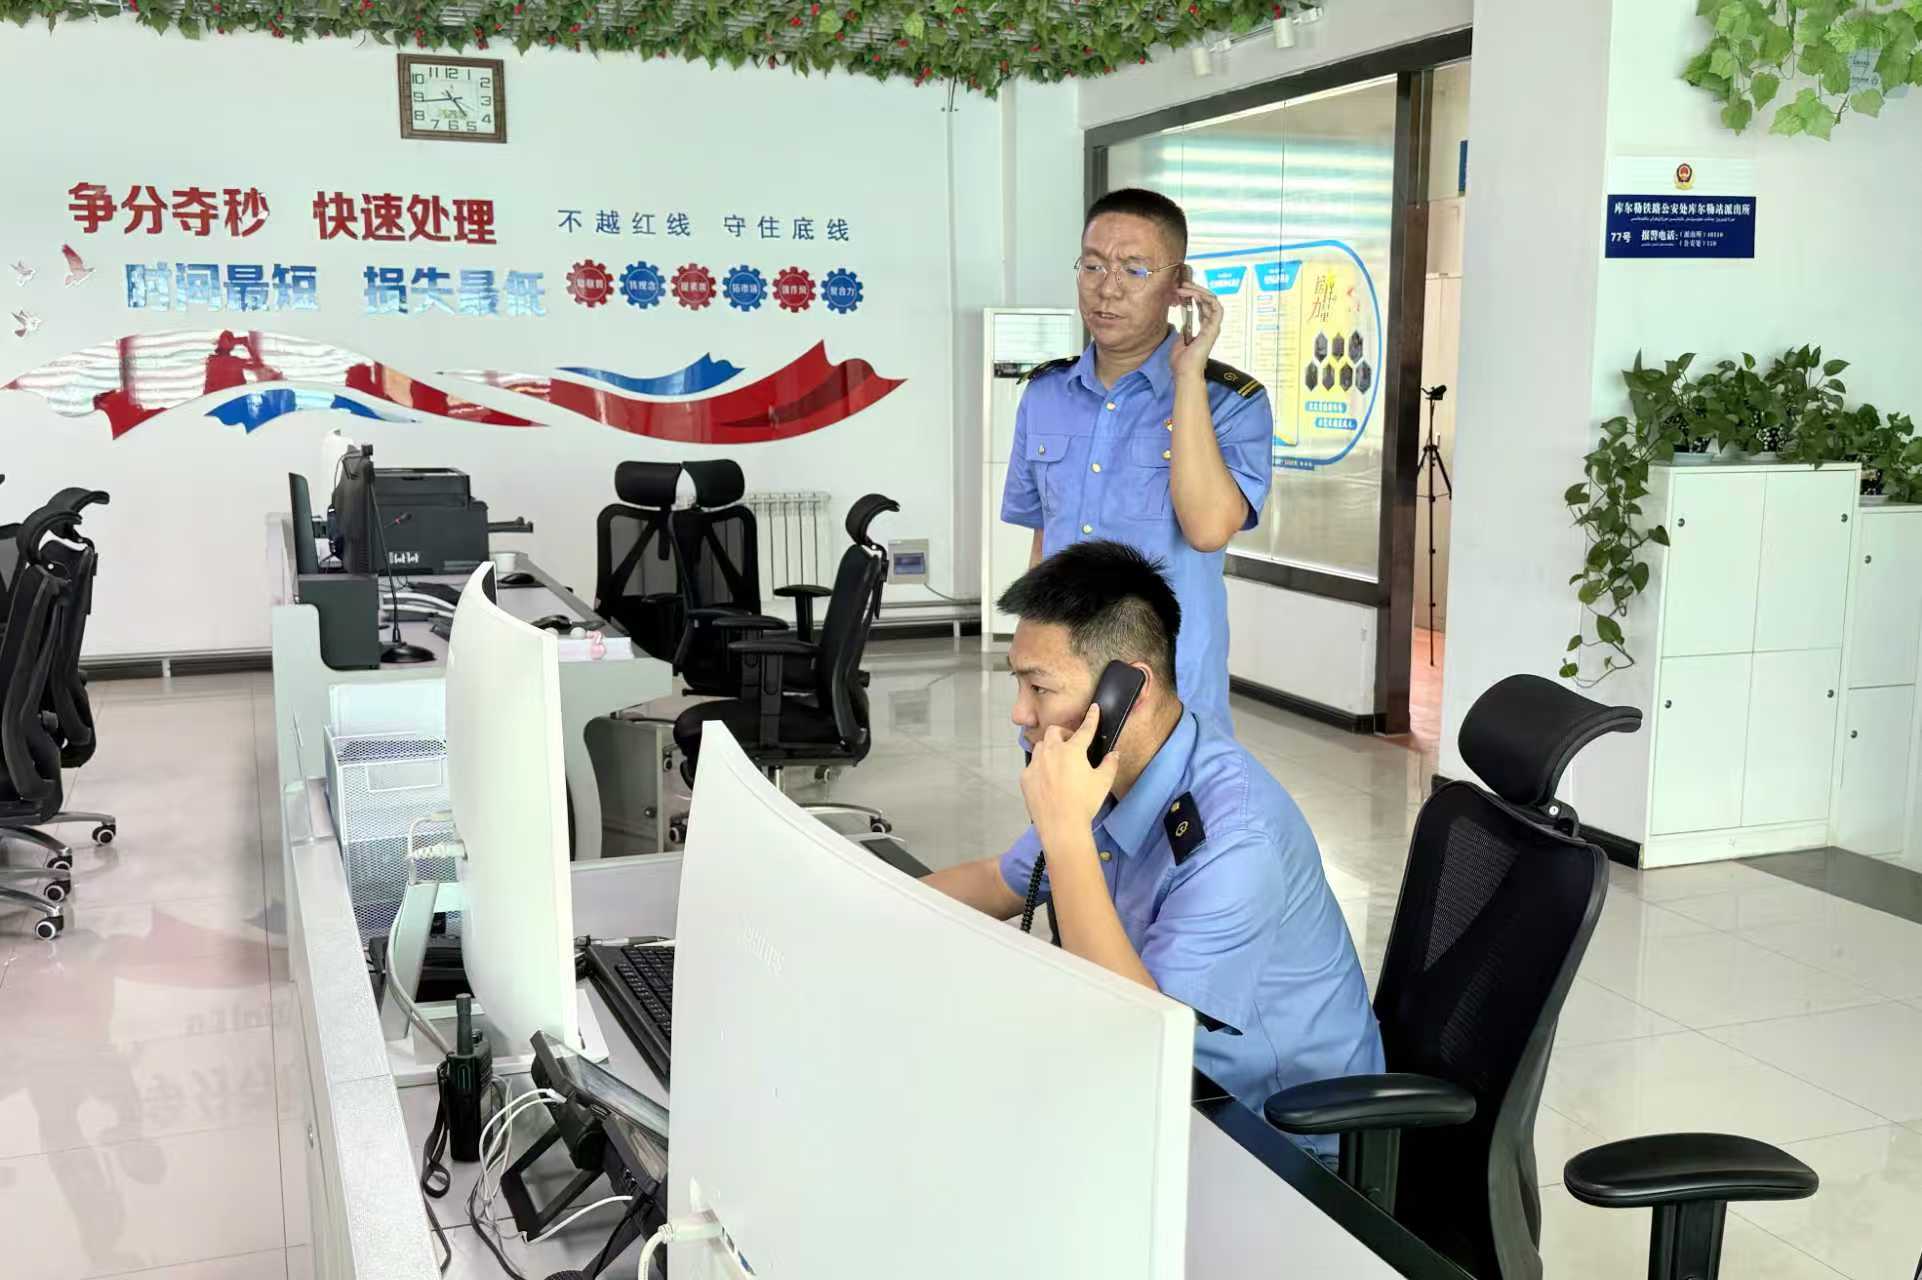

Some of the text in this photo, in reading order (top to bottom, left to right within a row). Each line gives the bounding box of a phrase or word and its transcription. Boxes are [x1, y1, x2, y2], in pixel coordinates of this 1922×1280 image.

[68, 182, 497, 245] 争分夺秒 快速处理
[557, 208, 850, 242] 不越红线 守住底线
[124, 260, 548, 318] 时间最短 损失最低
